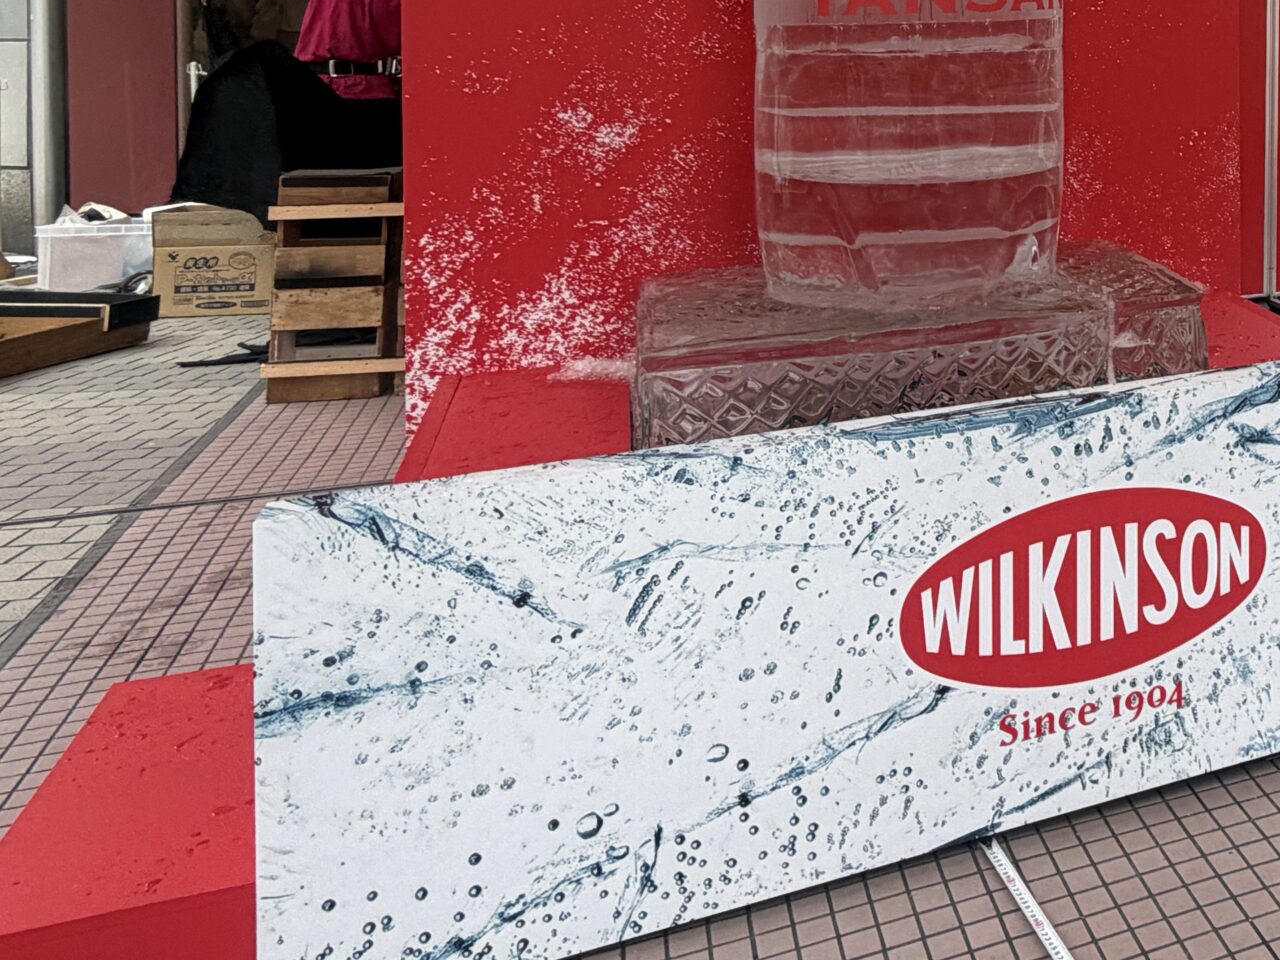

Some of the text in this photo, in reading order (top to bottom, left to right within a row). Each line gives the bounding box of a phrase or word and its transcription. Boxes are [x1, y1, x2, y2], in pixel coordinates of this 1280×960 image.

[921, 518, 1251, 658] WILKINSON
[999, 681, 1188, 747] Since 1904
